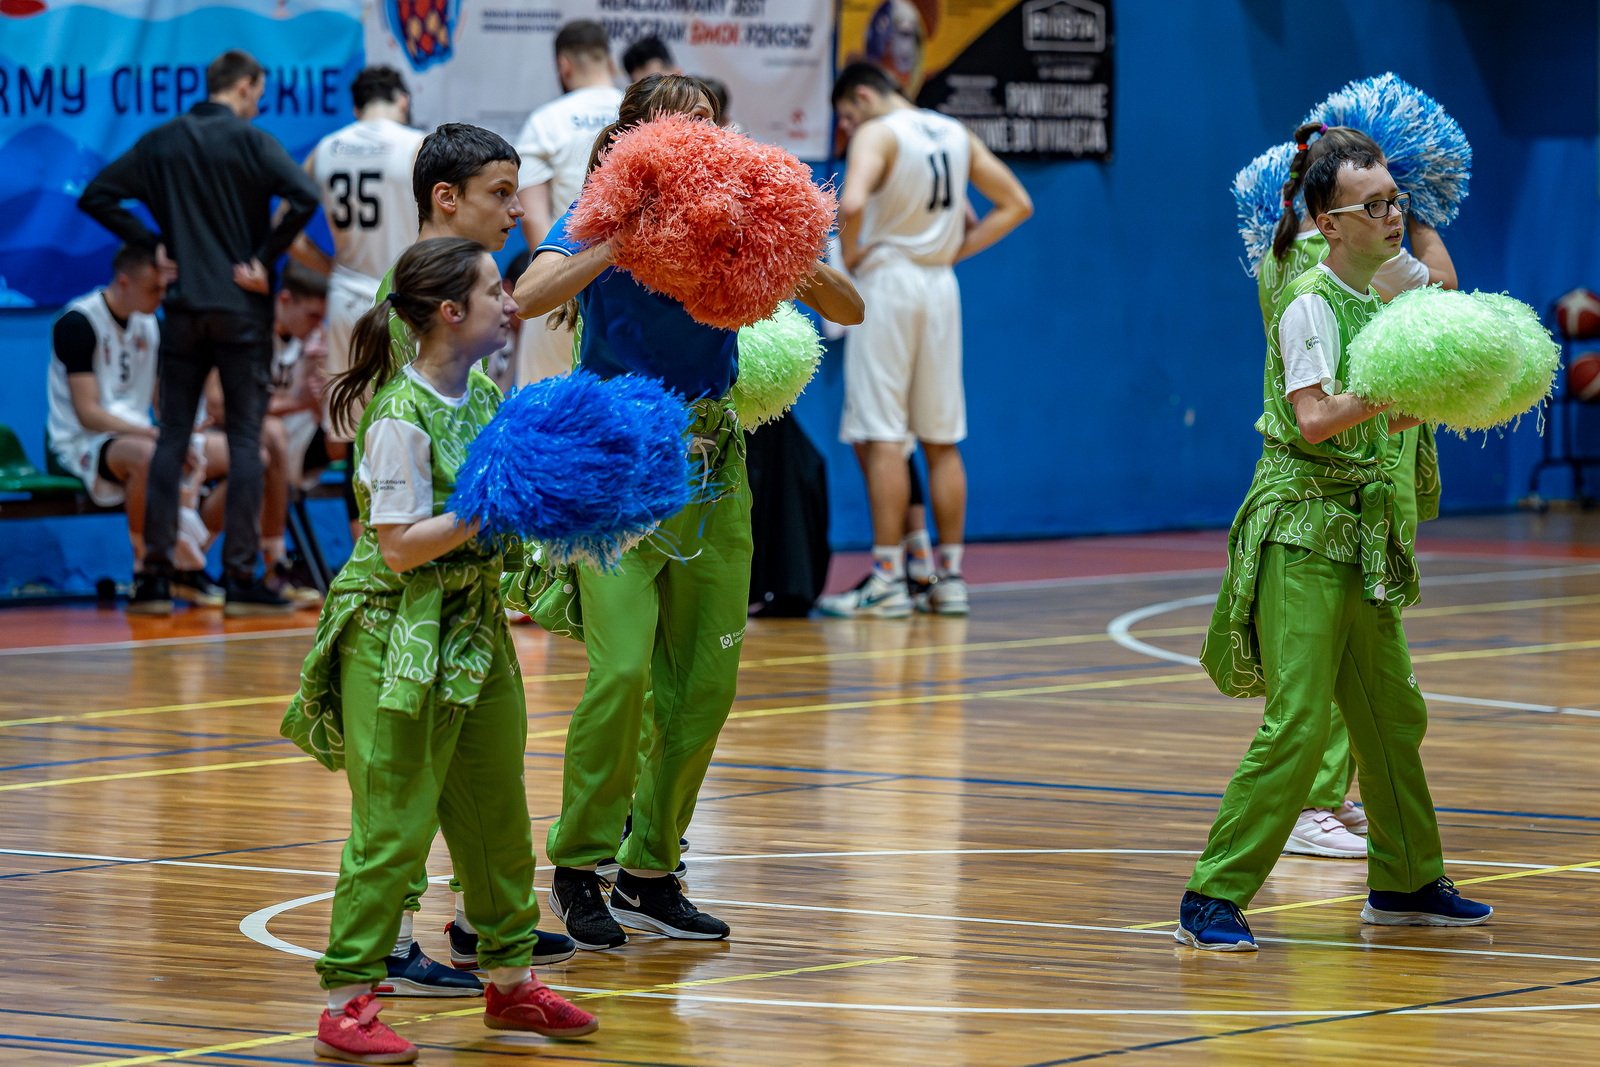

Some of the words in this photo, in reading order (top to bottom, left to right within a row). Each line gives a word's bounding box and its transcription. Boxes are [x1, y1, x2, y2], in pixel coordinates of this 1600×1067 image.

[112, 66, 341, 116] CIEPKIE
[329, 172, 382, 229] 35
[927, 152, 952, 211] 11
